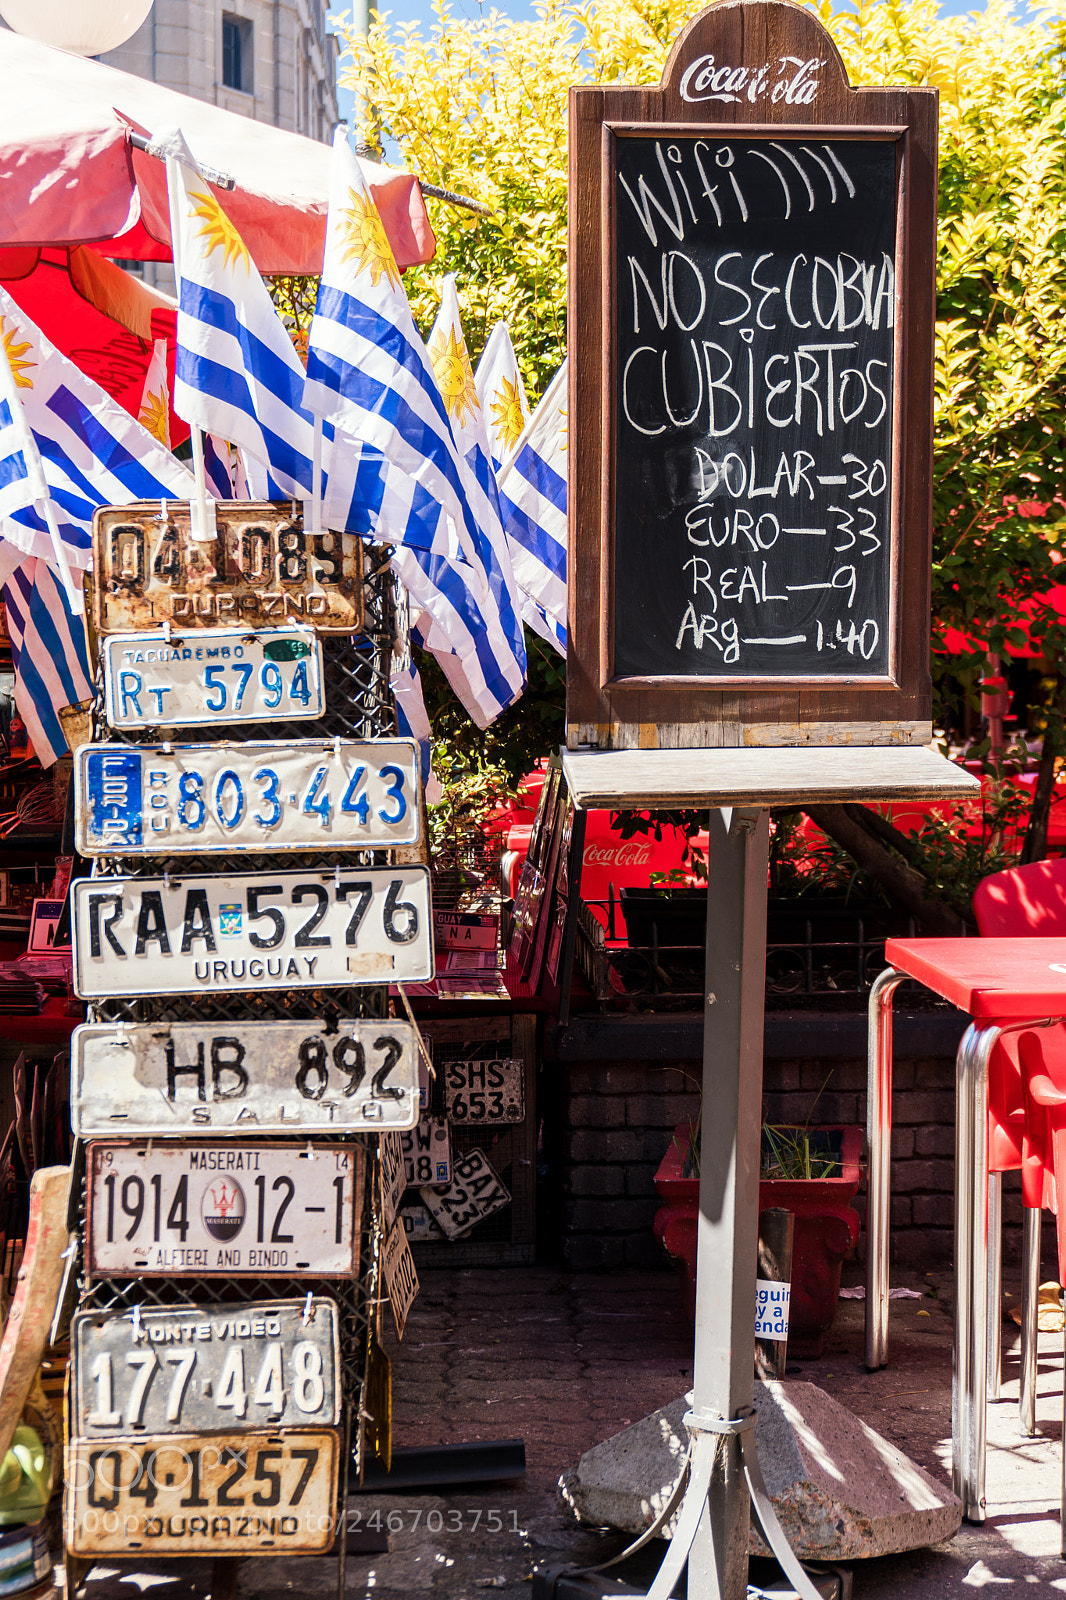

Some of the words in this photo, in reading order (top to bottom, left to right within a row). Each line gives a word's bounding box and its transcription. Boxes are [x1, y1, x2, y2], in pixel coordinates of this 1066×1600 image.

[618, 140, 749, 247] Wifi
[627, 250, 707, 333] NO
[203, 660, 313, 712] 5794
[99, 756, 129, 846] FLORIDA
[149, 770, 168, 832] ROU
[582, 841, 653, 867] Coca-Cola
[88, 888, 218, 958] RAA
[246, 880, 420, 950] 5276
[194, 956, 318, 982] URUGUAY
[163, 1036, 249, 1102] HB
[295, 1035, 406, 1101] 892
[450, 1060, 505, 1089] SHS
[191, 1100, 384, 1125] SALTO
[452, 1091, 504, 1120] 653
[188, 1151, 262, 1171] MASERATI
[457, 1155, 506, 1212] BAX
[104, 1174, 190, 1243] 1914
[156, 1249, 210, 1267] ALFIERI
[216, 1249, 241, 1267] AND
[249, 1250, 289, 1267] BINDO
[133, 1318, 282, 1343] MONTEVIDEO
[145, 1516, 299, 1538] DURAZNO
